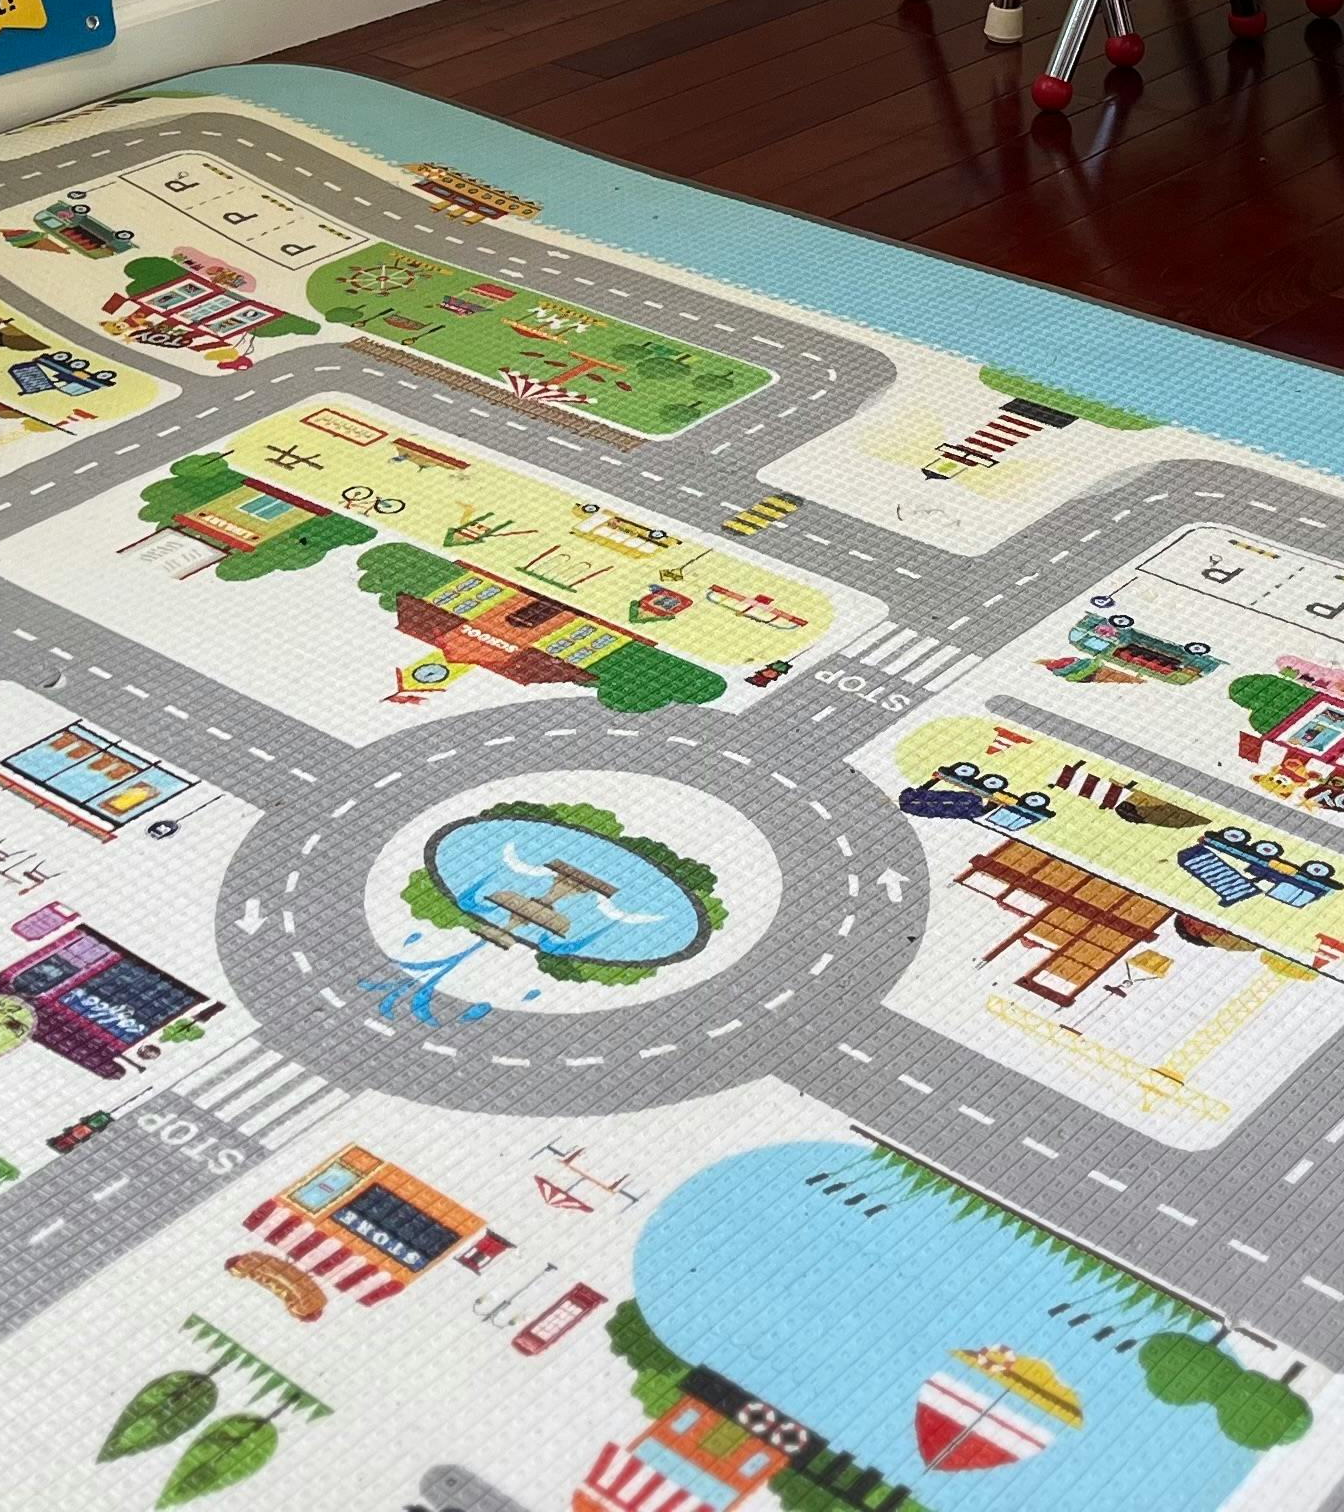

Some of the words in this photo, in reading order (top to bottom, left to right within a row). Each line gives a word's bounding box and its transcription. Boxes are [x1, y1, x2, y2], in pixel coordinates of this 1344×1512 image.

[165, 177, 200, 194] P
[223, 210, 257, 226] P
[287, 243, 317, 257] P
[137, 331, 181, 347] TOY
[1201, 567, 1242, 584] P
[461, 622, 517, 654] SCHOOL
[813, 668, 910, 713] STOP
[138, 1110, 243, 1174] STOP
[340, 1208, 426, 1268] STORE
